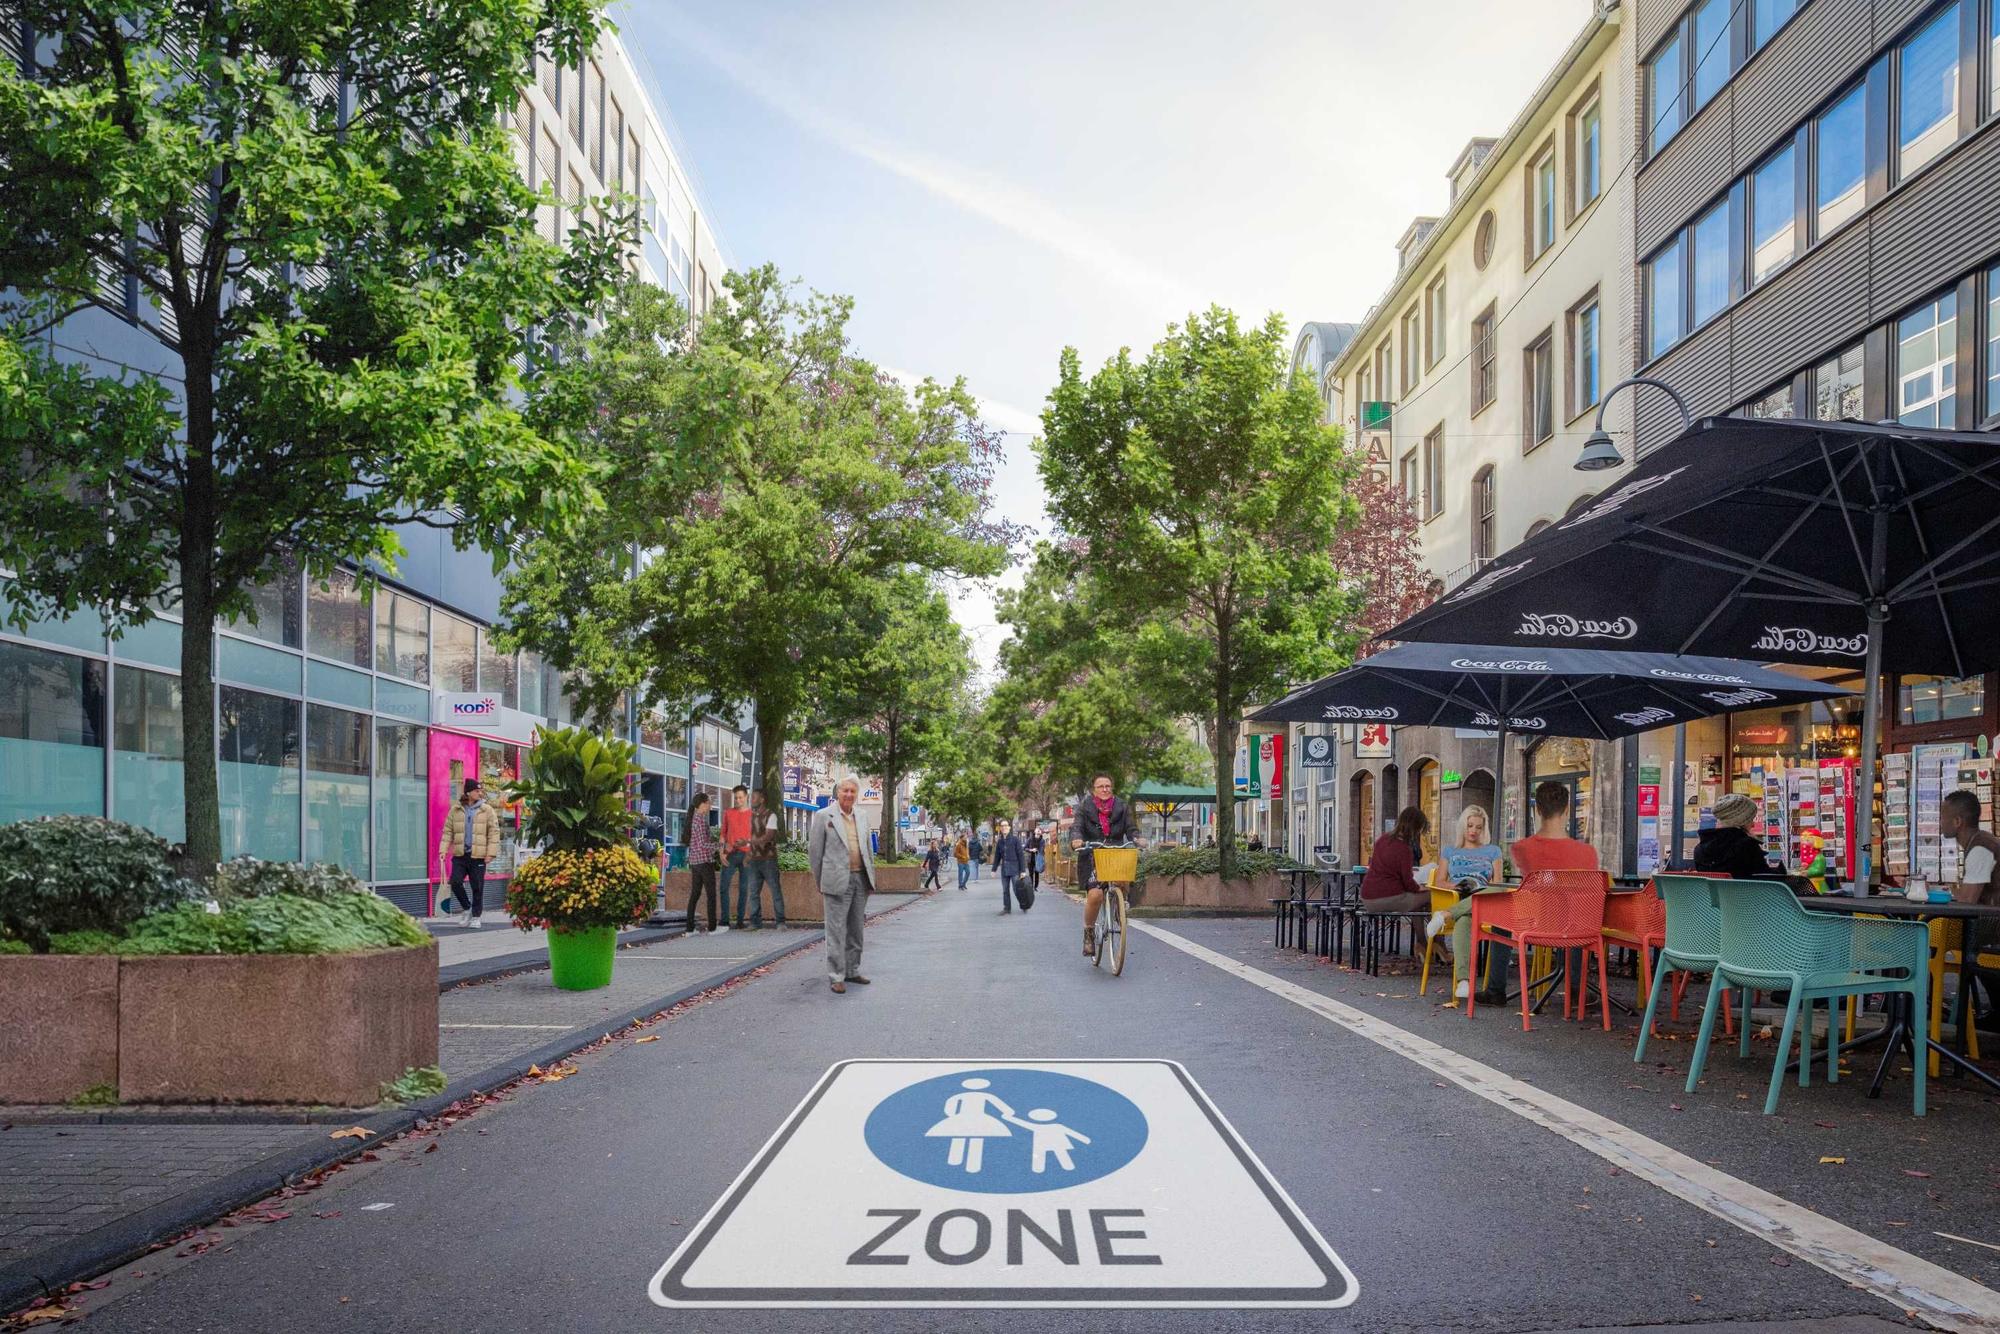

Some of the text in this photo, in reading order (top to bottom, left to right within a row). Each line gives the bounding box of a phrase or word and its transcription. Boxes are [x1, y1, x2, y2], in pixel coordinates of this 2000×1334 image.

[1450, 658, 1553, 671] Coca-Cola
[864, 790, 878, 798] dm
[845, 1208, 1163, 1266] ZONE
